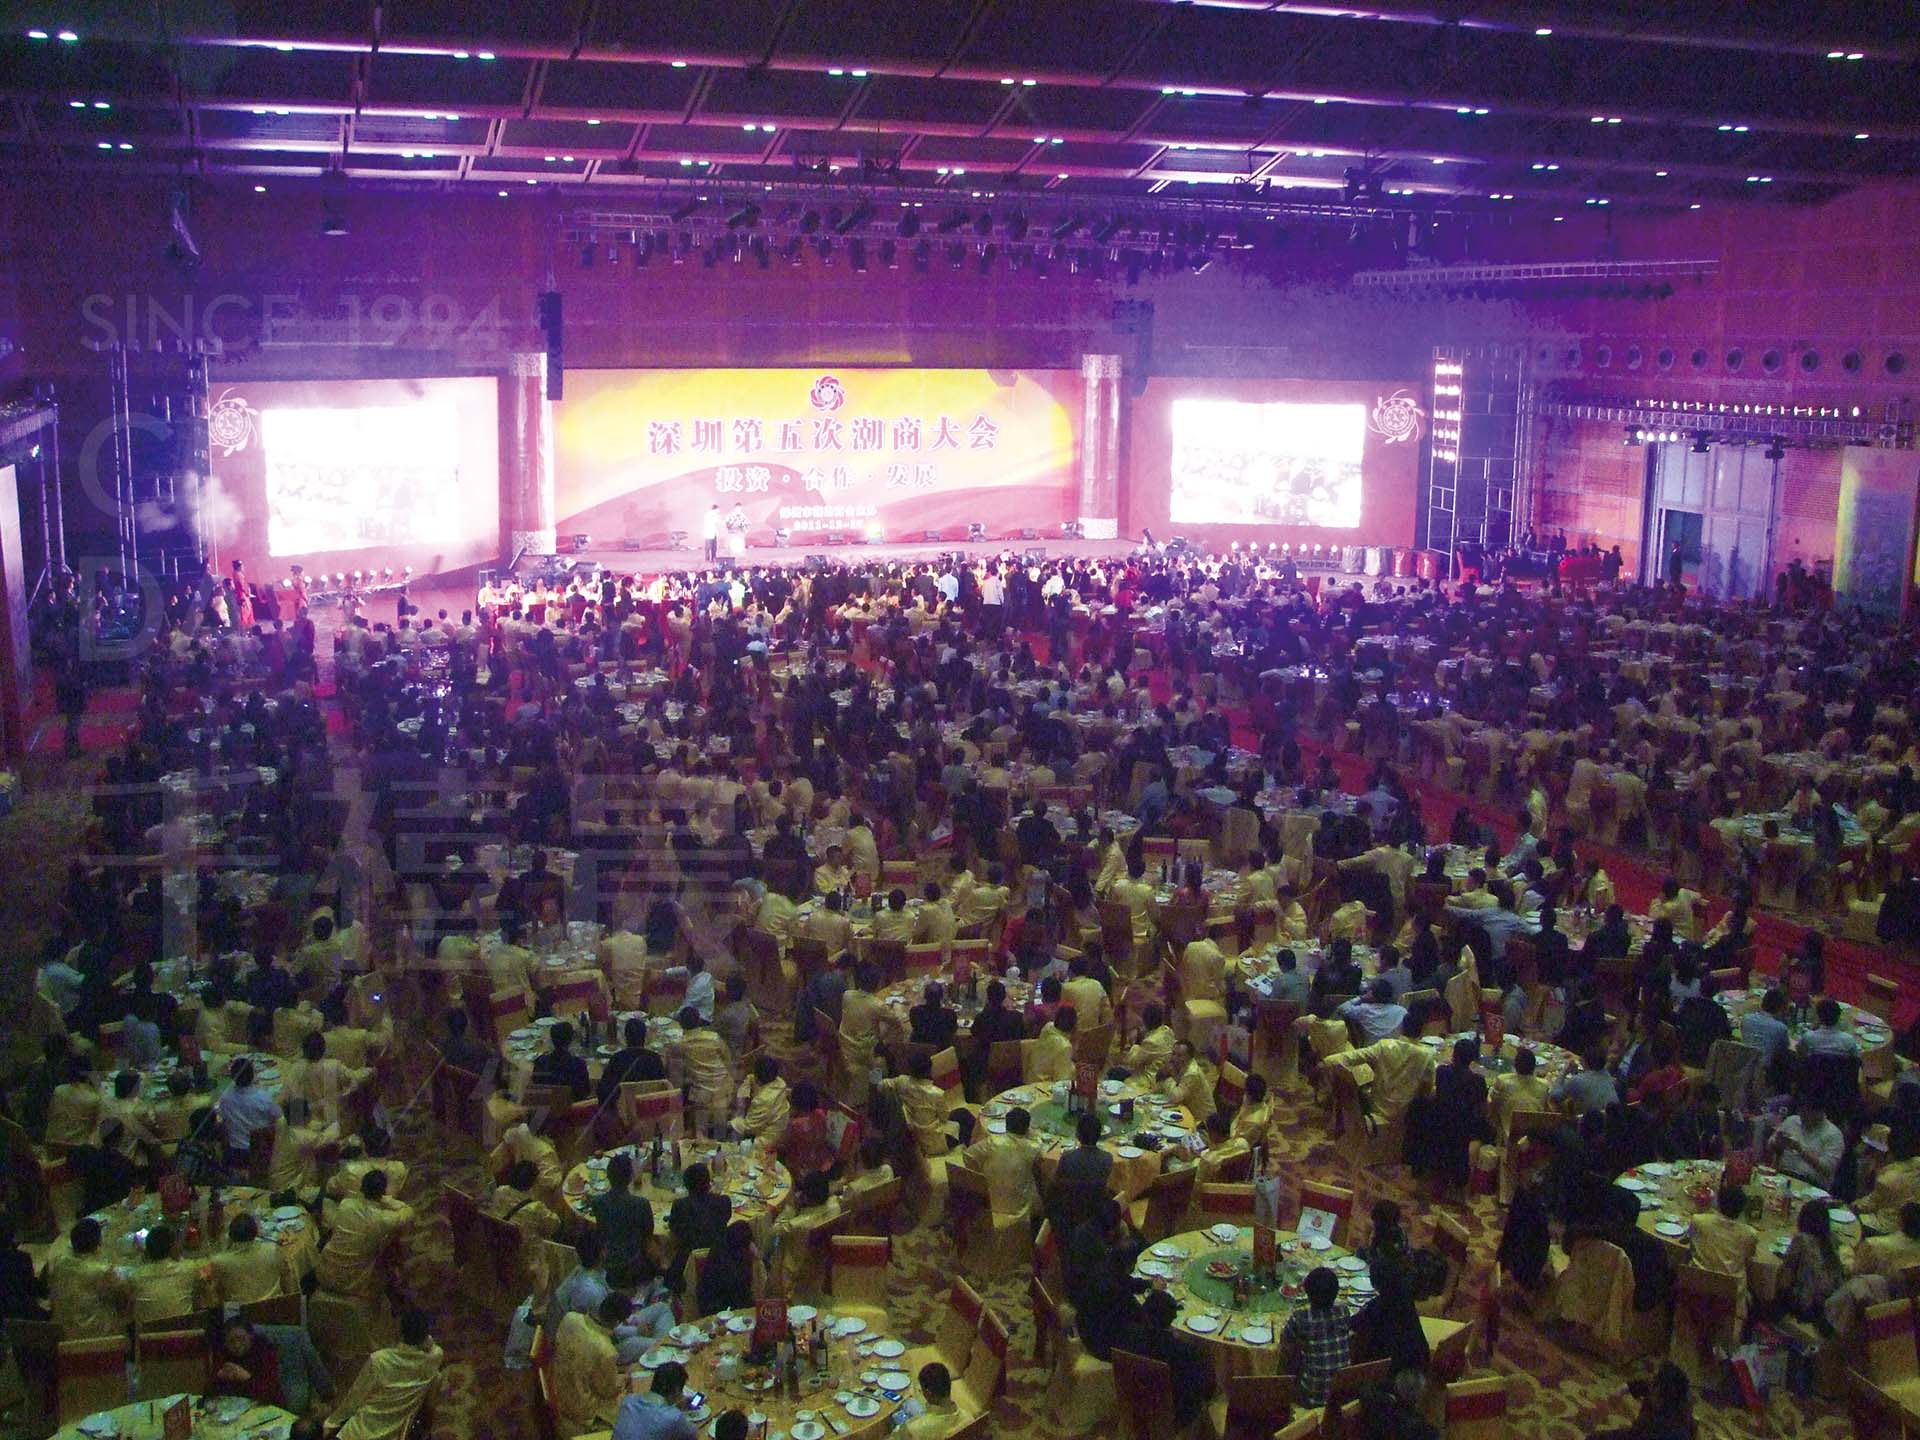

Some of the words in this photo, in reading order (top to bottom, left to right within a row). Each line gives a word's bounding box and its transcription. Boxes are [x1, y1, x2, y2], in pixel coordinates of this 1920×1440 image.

[648, 415, 1000, 454] 深圳第五次潮商大会
